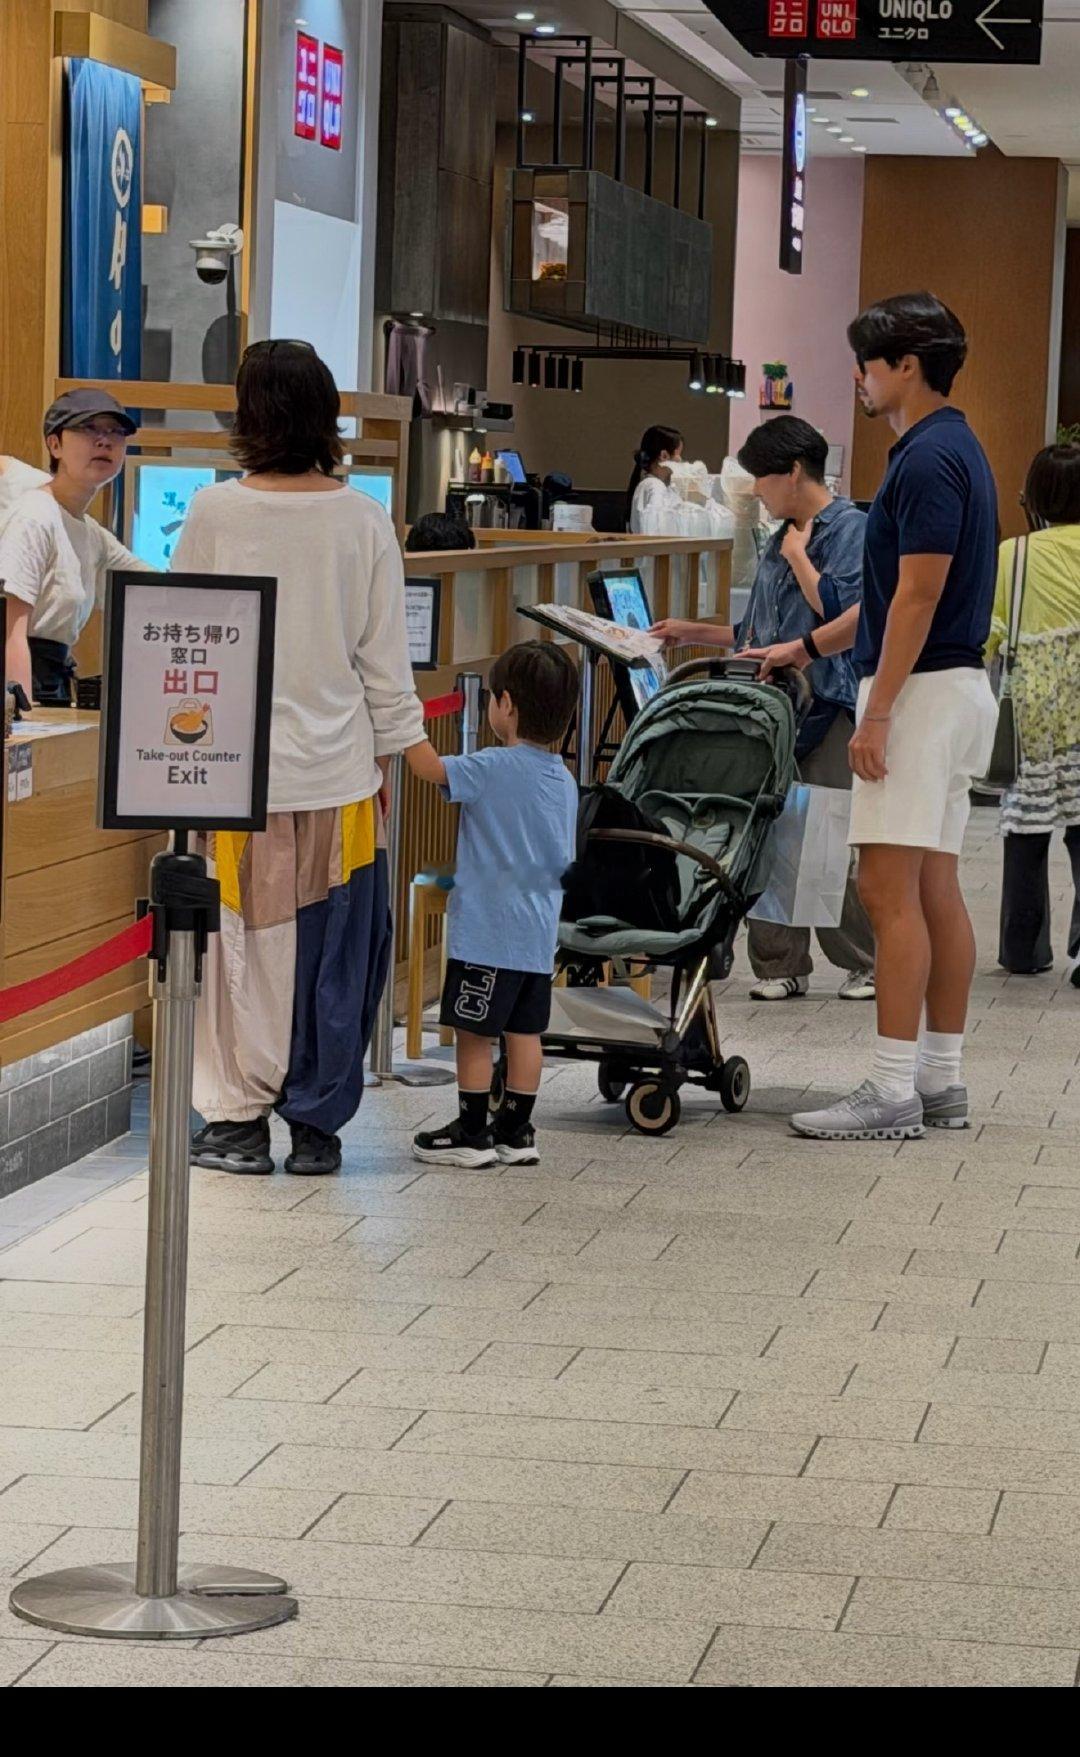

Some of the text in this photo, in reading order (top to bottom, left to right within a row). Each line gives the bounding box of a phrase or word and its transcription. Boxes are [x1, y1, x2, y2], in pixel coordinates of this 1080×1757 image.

[774, 1, 803, 16] ユニ
[820, 3, 851, 18] UNI
[879, 0, 953, 22] UNIQLO
[772, 18, 803, 33] クロ
[820, 19, 851, 36] QLO
[878, 27, 929, 40] ユニクロ
[142, 622, 241, 645] お持ち帰り
[170, 647, 207, 665] 窓口
[163, 668, 219, 695] 出口
[136, 748, 242, 763] Take-out Counter
[167, 765, 208, 785] Exit
